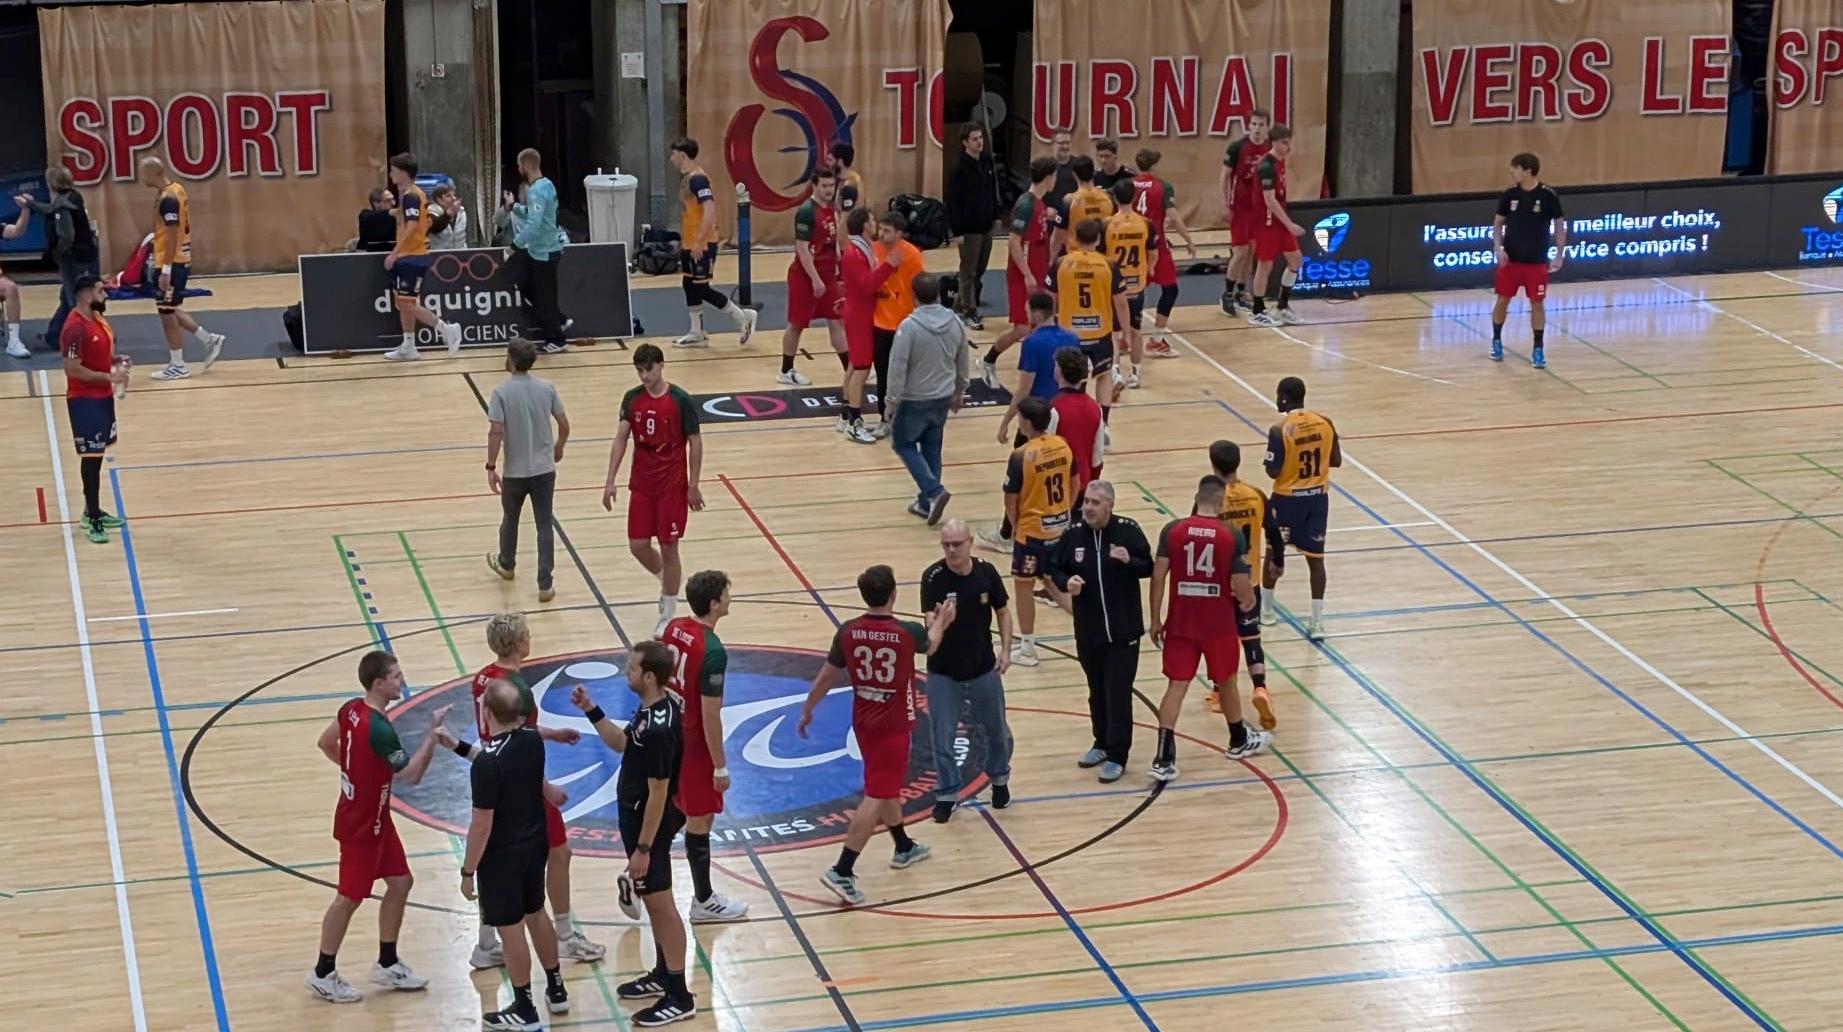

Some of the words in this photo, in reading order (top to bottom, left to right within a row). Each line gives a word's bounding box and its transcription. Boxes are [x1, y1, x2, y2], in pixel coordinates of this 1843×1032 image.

[1421, 38, 1611, 126] VERS
[1640, 35, 1730, 116] LE
[59, 89, 331, 186] SPORT
[1136, 190, 1148, 215] 4
[1573, 212, 1658, 234] meilleur
[1660, 208, 1721, 230] choix,
[1115, 245, 1140, 268] 24
[1614, 235, 1697, 257] compris
[1078, 283, 1091, 309] 5
[646, 418, 656, 435] 9
[1298, 447, 1321, 480] 31
[1044, 472, 1065, 506] 13
[1183, 541, 1216, 578] 14
[852, 629, 869, 641] VAN
[868, 631, 900, 643] GESTEL
[853, 645, 898, 684] 33
